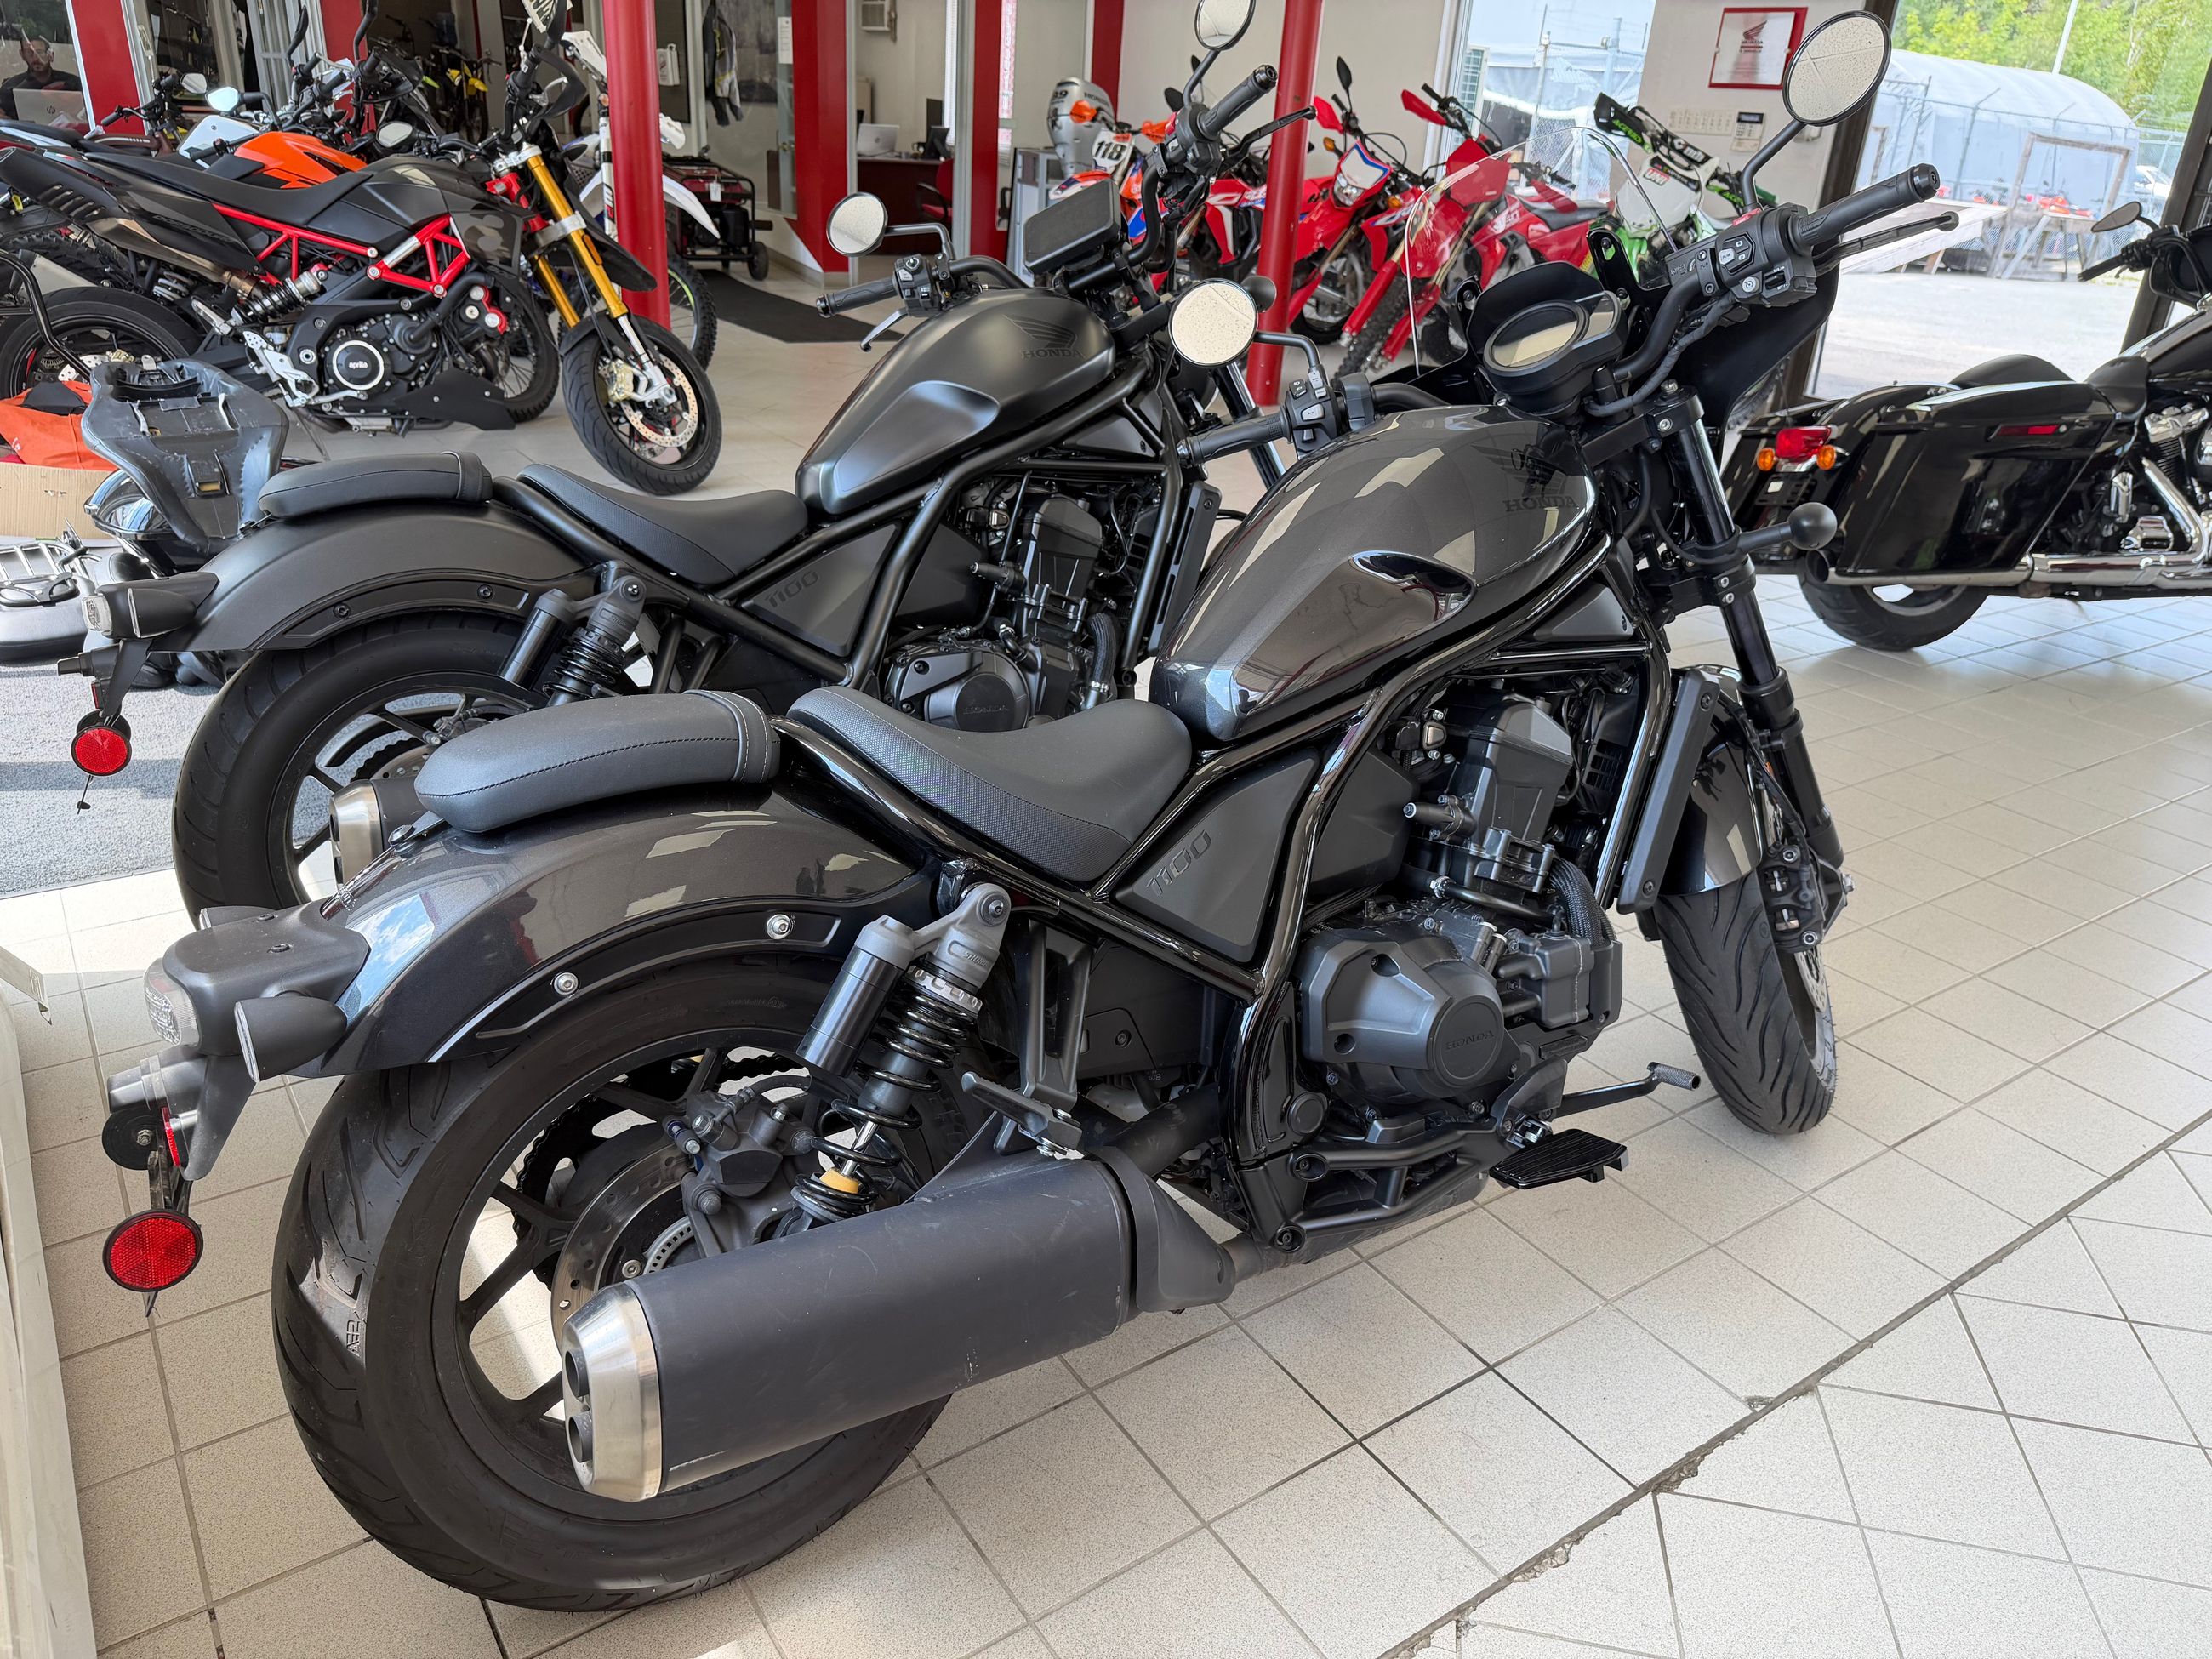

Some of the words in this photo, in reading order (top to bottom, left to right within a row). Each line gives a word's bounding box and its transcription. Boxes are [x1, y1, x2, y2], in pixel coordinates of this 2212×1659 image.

[1094, 140, 1127, 161] 118
[1020, 349, 1086, 359] HONDA
[348, 361, 368, 369] aprilia
[1502, 495, 1577, 512] HONDA
[765, 571, 818, 608] 1100
[1146, 830, 1211, 897] 1100
[1446, 1029, 1496, 1051] HONDA
